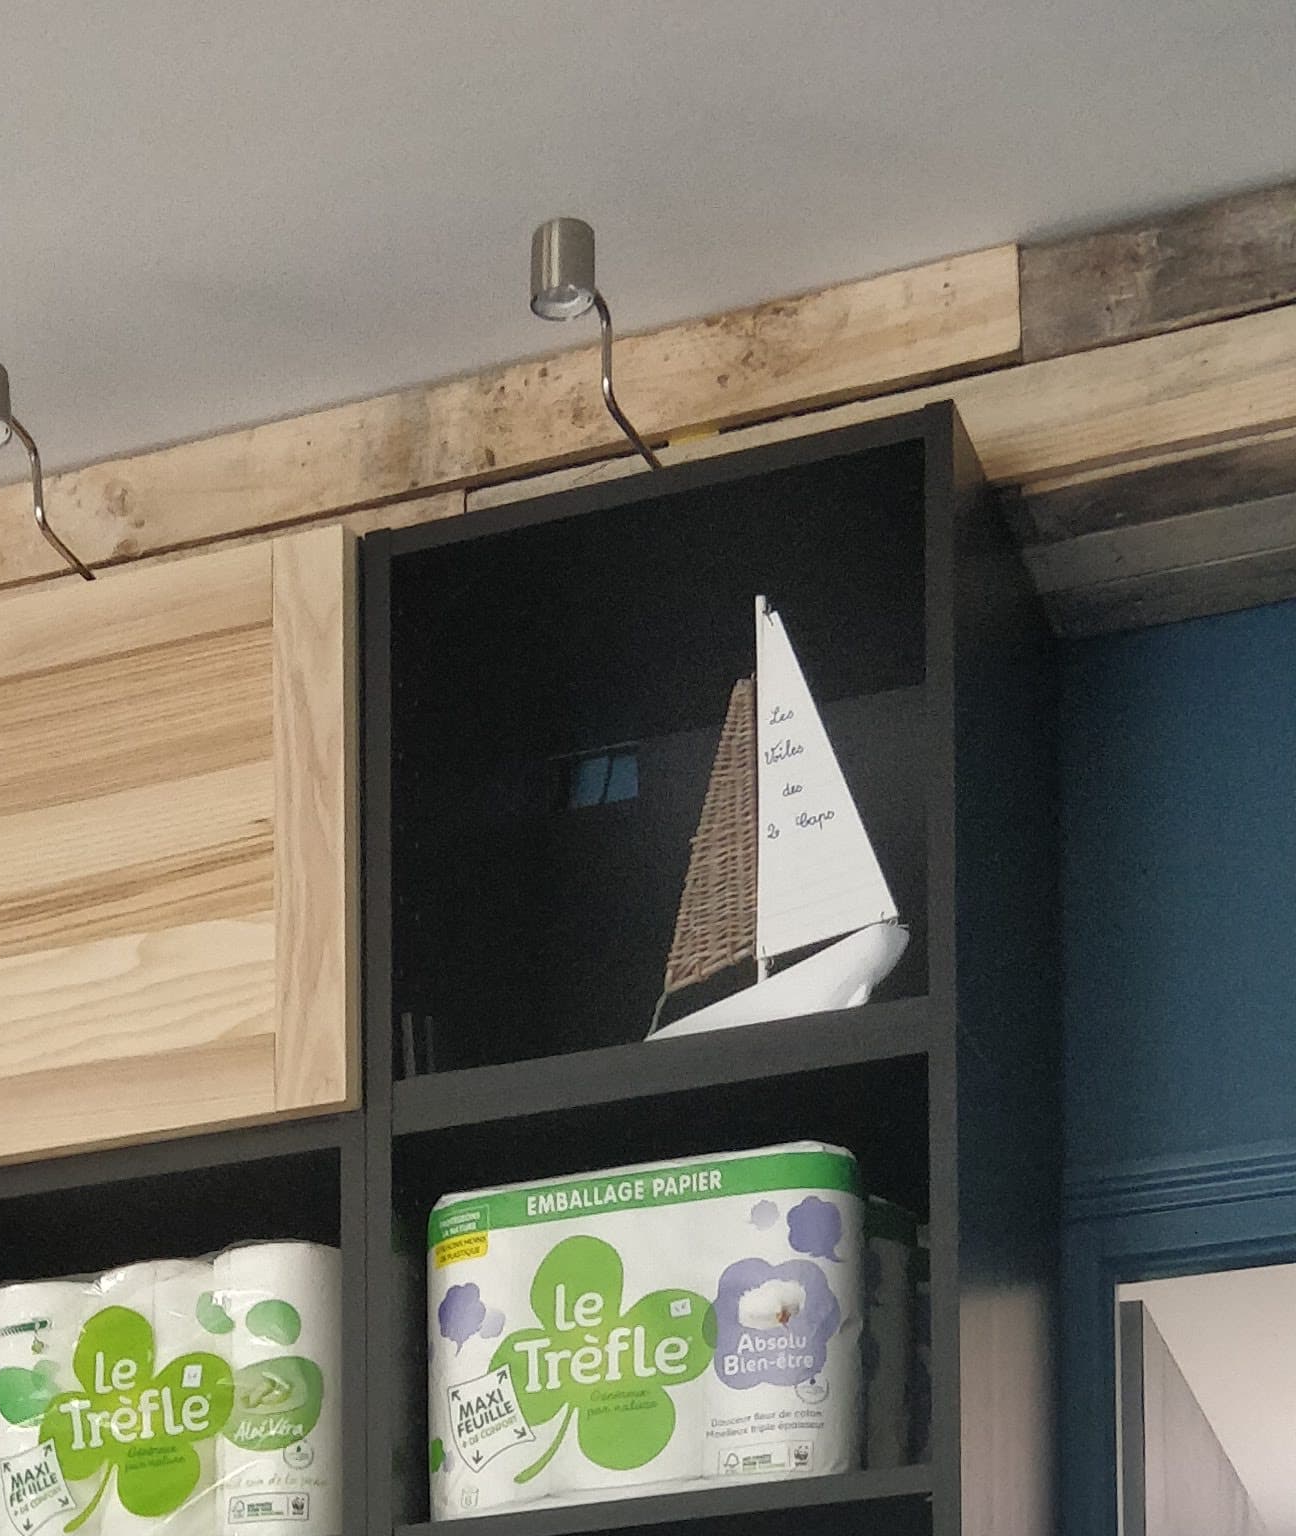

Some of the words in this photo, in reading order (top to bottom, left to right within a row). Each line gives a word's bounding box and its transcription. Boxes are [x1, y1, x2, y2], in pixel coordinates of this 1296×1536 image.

[769, 708, 794, 725] Les
[783, 783, 802, 797] des
[767, 824, 780, 839] 2
[526, 1181, 645, 1217] EMBALLAGE
[653, 1169, 722, 1198] PAPIER
[737, 1333, 807, 1354] Absolu
[514, 1326, 689, 1393] Trèfle
[724, 1352, 814, 1376] Bien-être
[59, 1386, 209, 1450] Trèfle
[457, 1401, 515, 1438] FEUILLE
[459, 1388, 504, 1422] MAXI
[11, 1461, 50, 1491] MAXI
